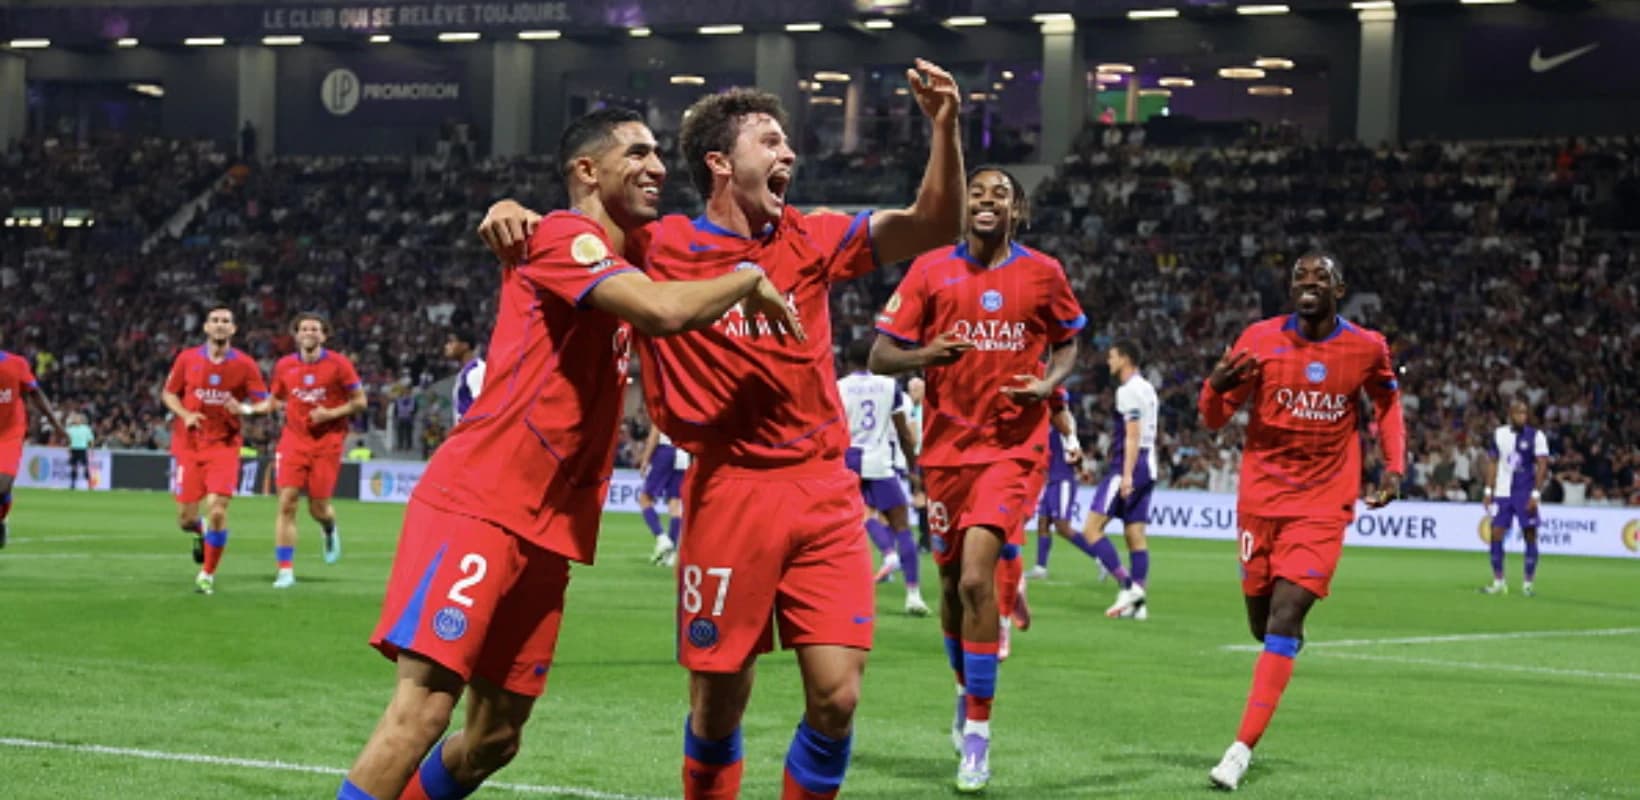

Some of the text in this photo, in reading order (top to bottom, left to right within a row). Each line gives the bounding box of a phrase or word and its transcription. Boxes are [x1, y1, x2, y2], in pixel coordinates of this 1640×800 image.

[263, 8, 286, 29] LE
[289, 7, 335, 28] CLUB
[339, 7, 369, 29] QUI
[372, 7, 396, 27] SE
[363, 82, 460, 101] PROMOTION
[953, 319, 1026, 340] QATAR
[1276, 387, 1347, 411] QATAR
[860, 399, 877, 431] 3
[447, 553, 488, 608] 2
[683, 565, 733, 617] 87
